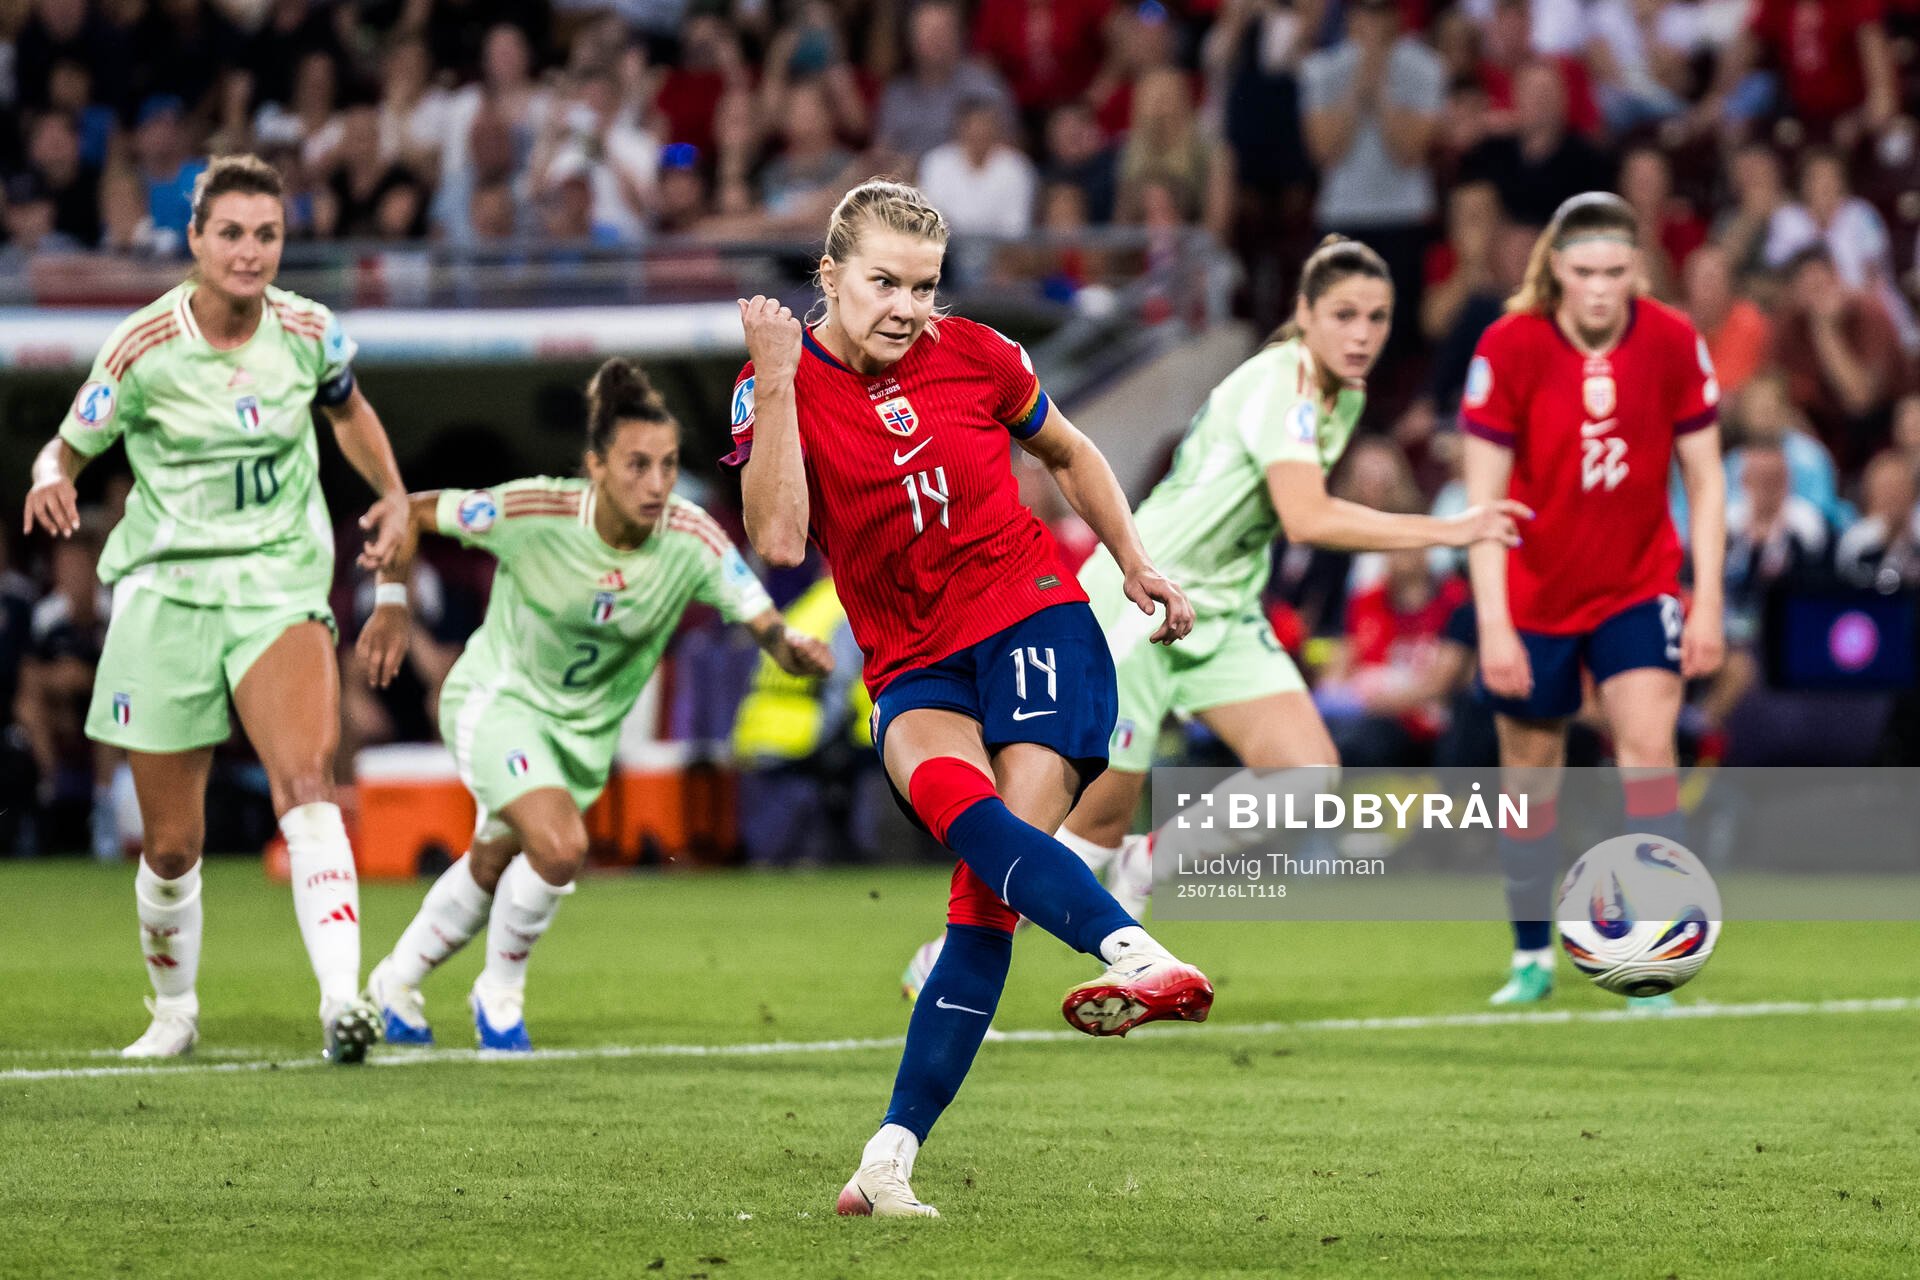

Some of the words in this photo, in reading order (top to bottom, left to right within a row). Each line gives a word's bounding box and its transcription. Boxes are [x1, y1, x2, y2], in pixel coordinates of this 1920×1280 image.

[885, 377, 896, 386] ITA
[235, 455, 280, 511] 10
[1581, 437, 1630, 493] 22
[901, 466, 949, 535] 14
[562, 641, 599, 688] 2
[1009, 647, 1057, 702] 14
